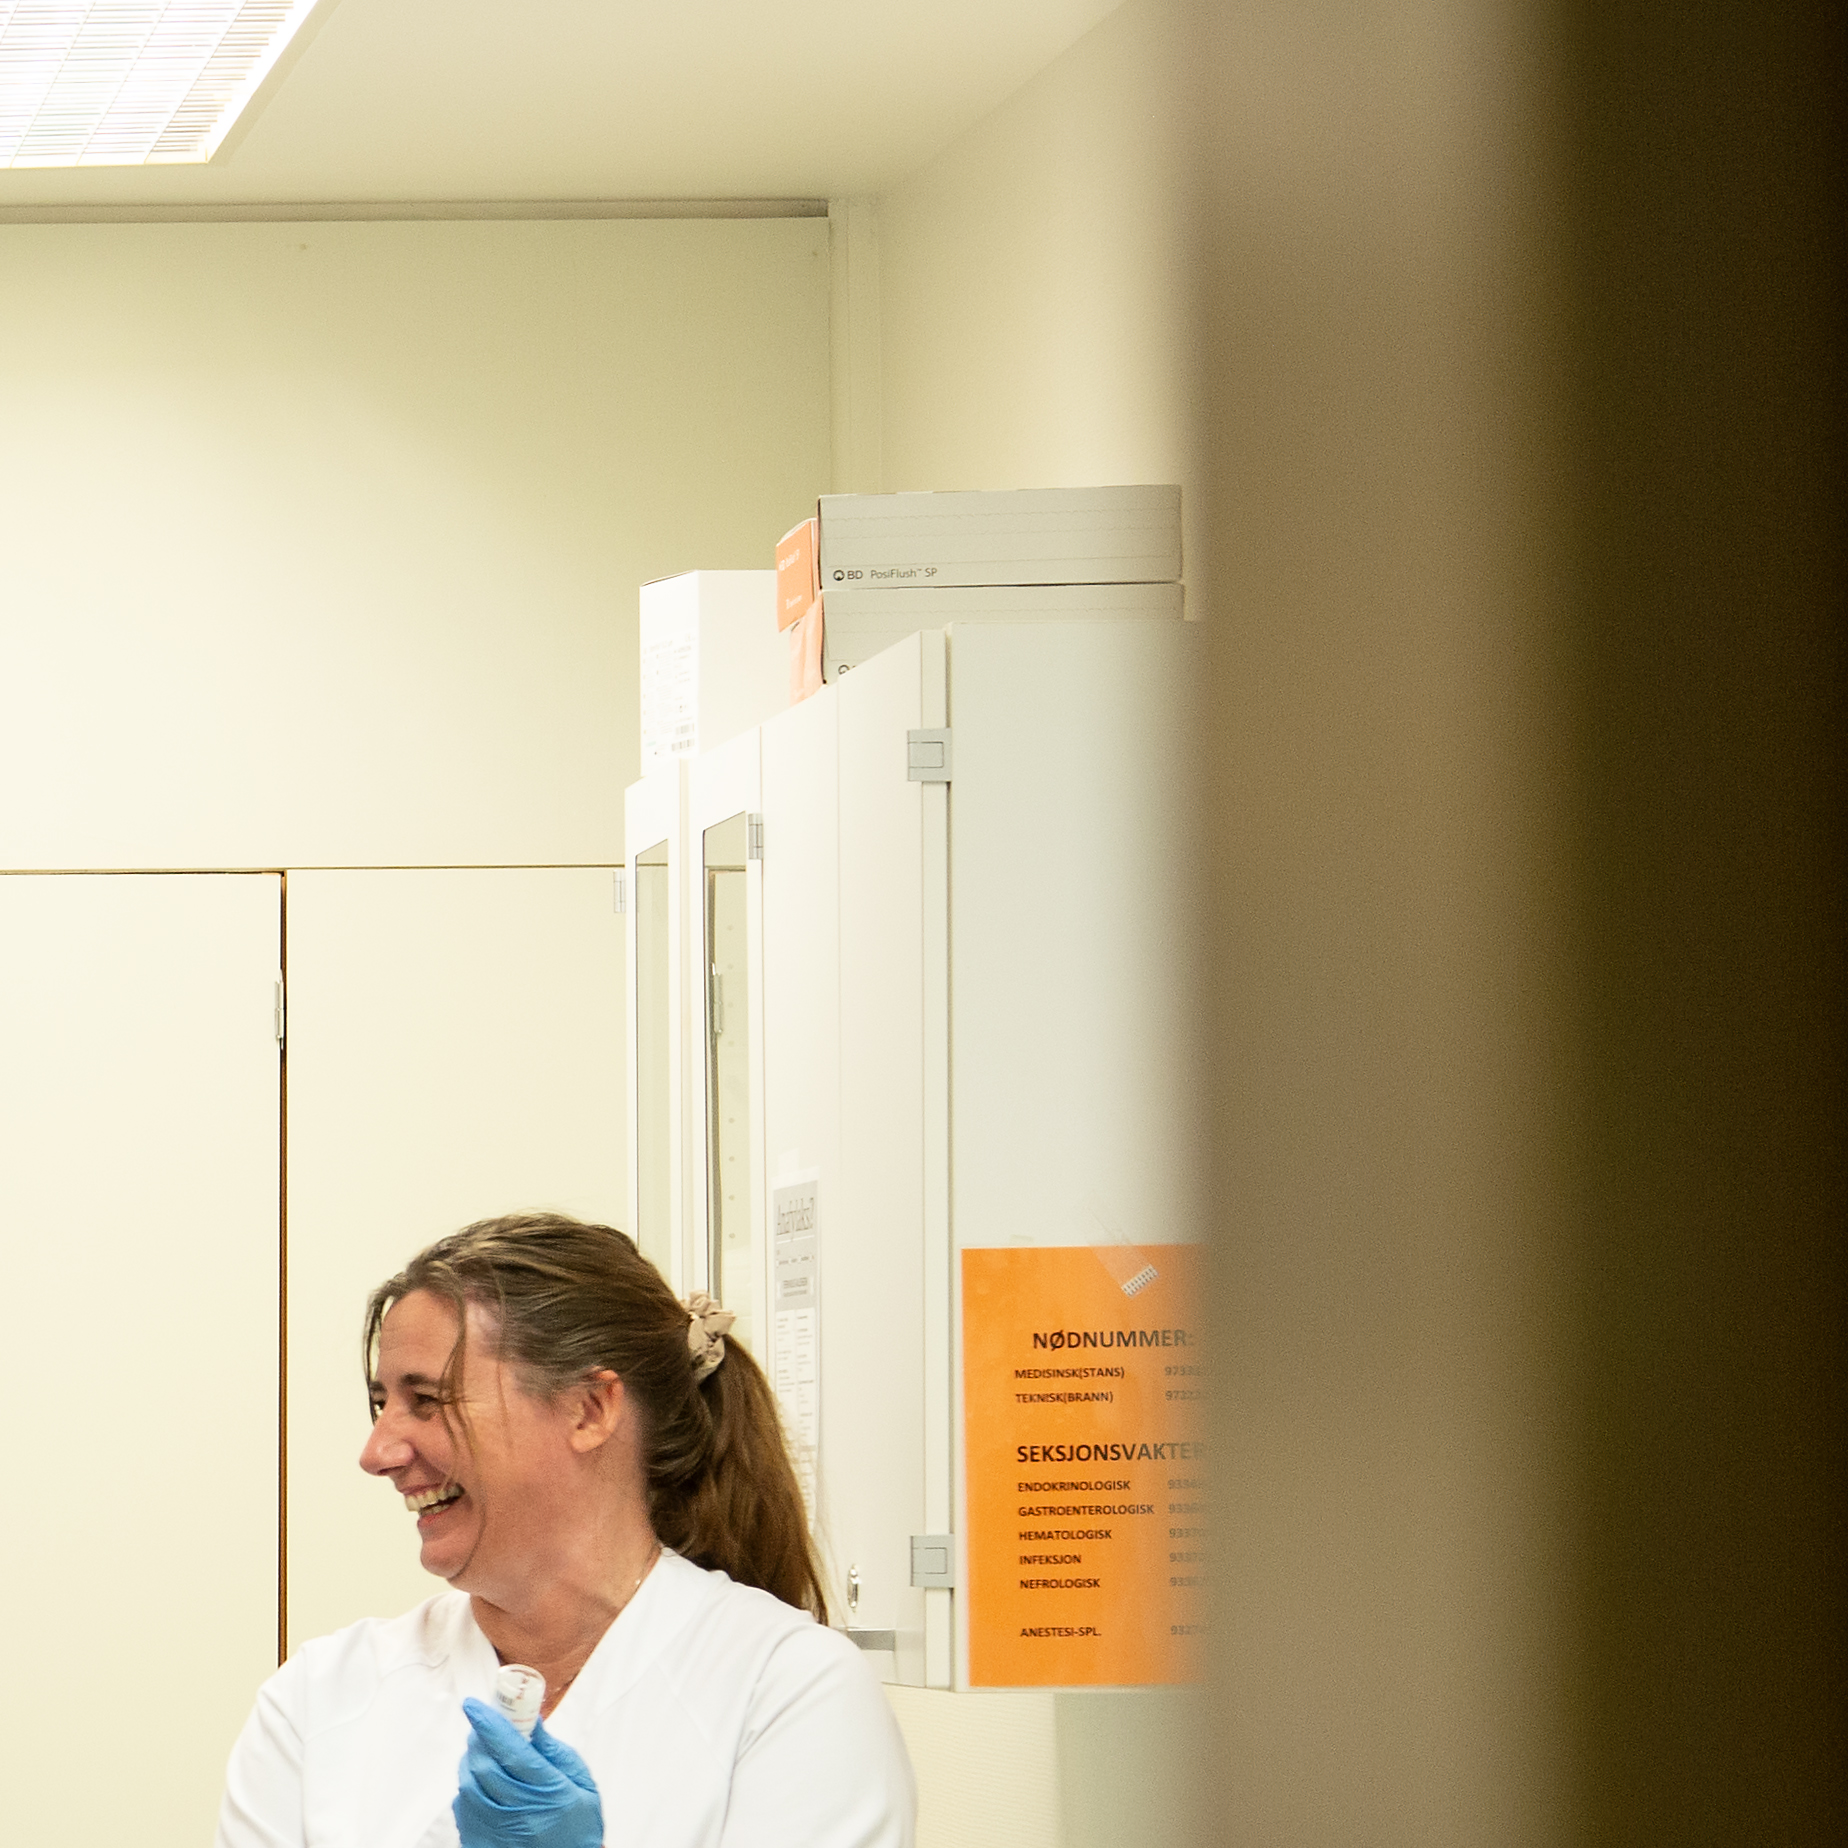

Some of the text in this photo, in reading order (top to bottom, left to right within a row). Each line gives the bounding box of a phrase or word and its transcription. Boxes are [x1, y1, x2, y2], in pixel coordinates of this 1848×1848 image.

[847, 570, 863, 580] BD
[924, 568, 938, 577] SP
[1015, 1367, 1125, 1380] MEDISINSK(STANS)
[1015, 1391, 1114, 1404] TEKNISK(BRANN)
[1018, 1480, 1131, 1492] ENDOKRINOLOGISK
[1018, 1504, 1155, 1517] GASTROENTEROLOGISK
[1019, 1529, 1113, 1541] HEMATOLOGISK
[1019, 1554, 1082, 1565] INFEKSJON
[1020, 1578, 1101, 1589] NEFROLOGISK
[1020, 1627, 1102, 1638] ANESTESI-SPL.
